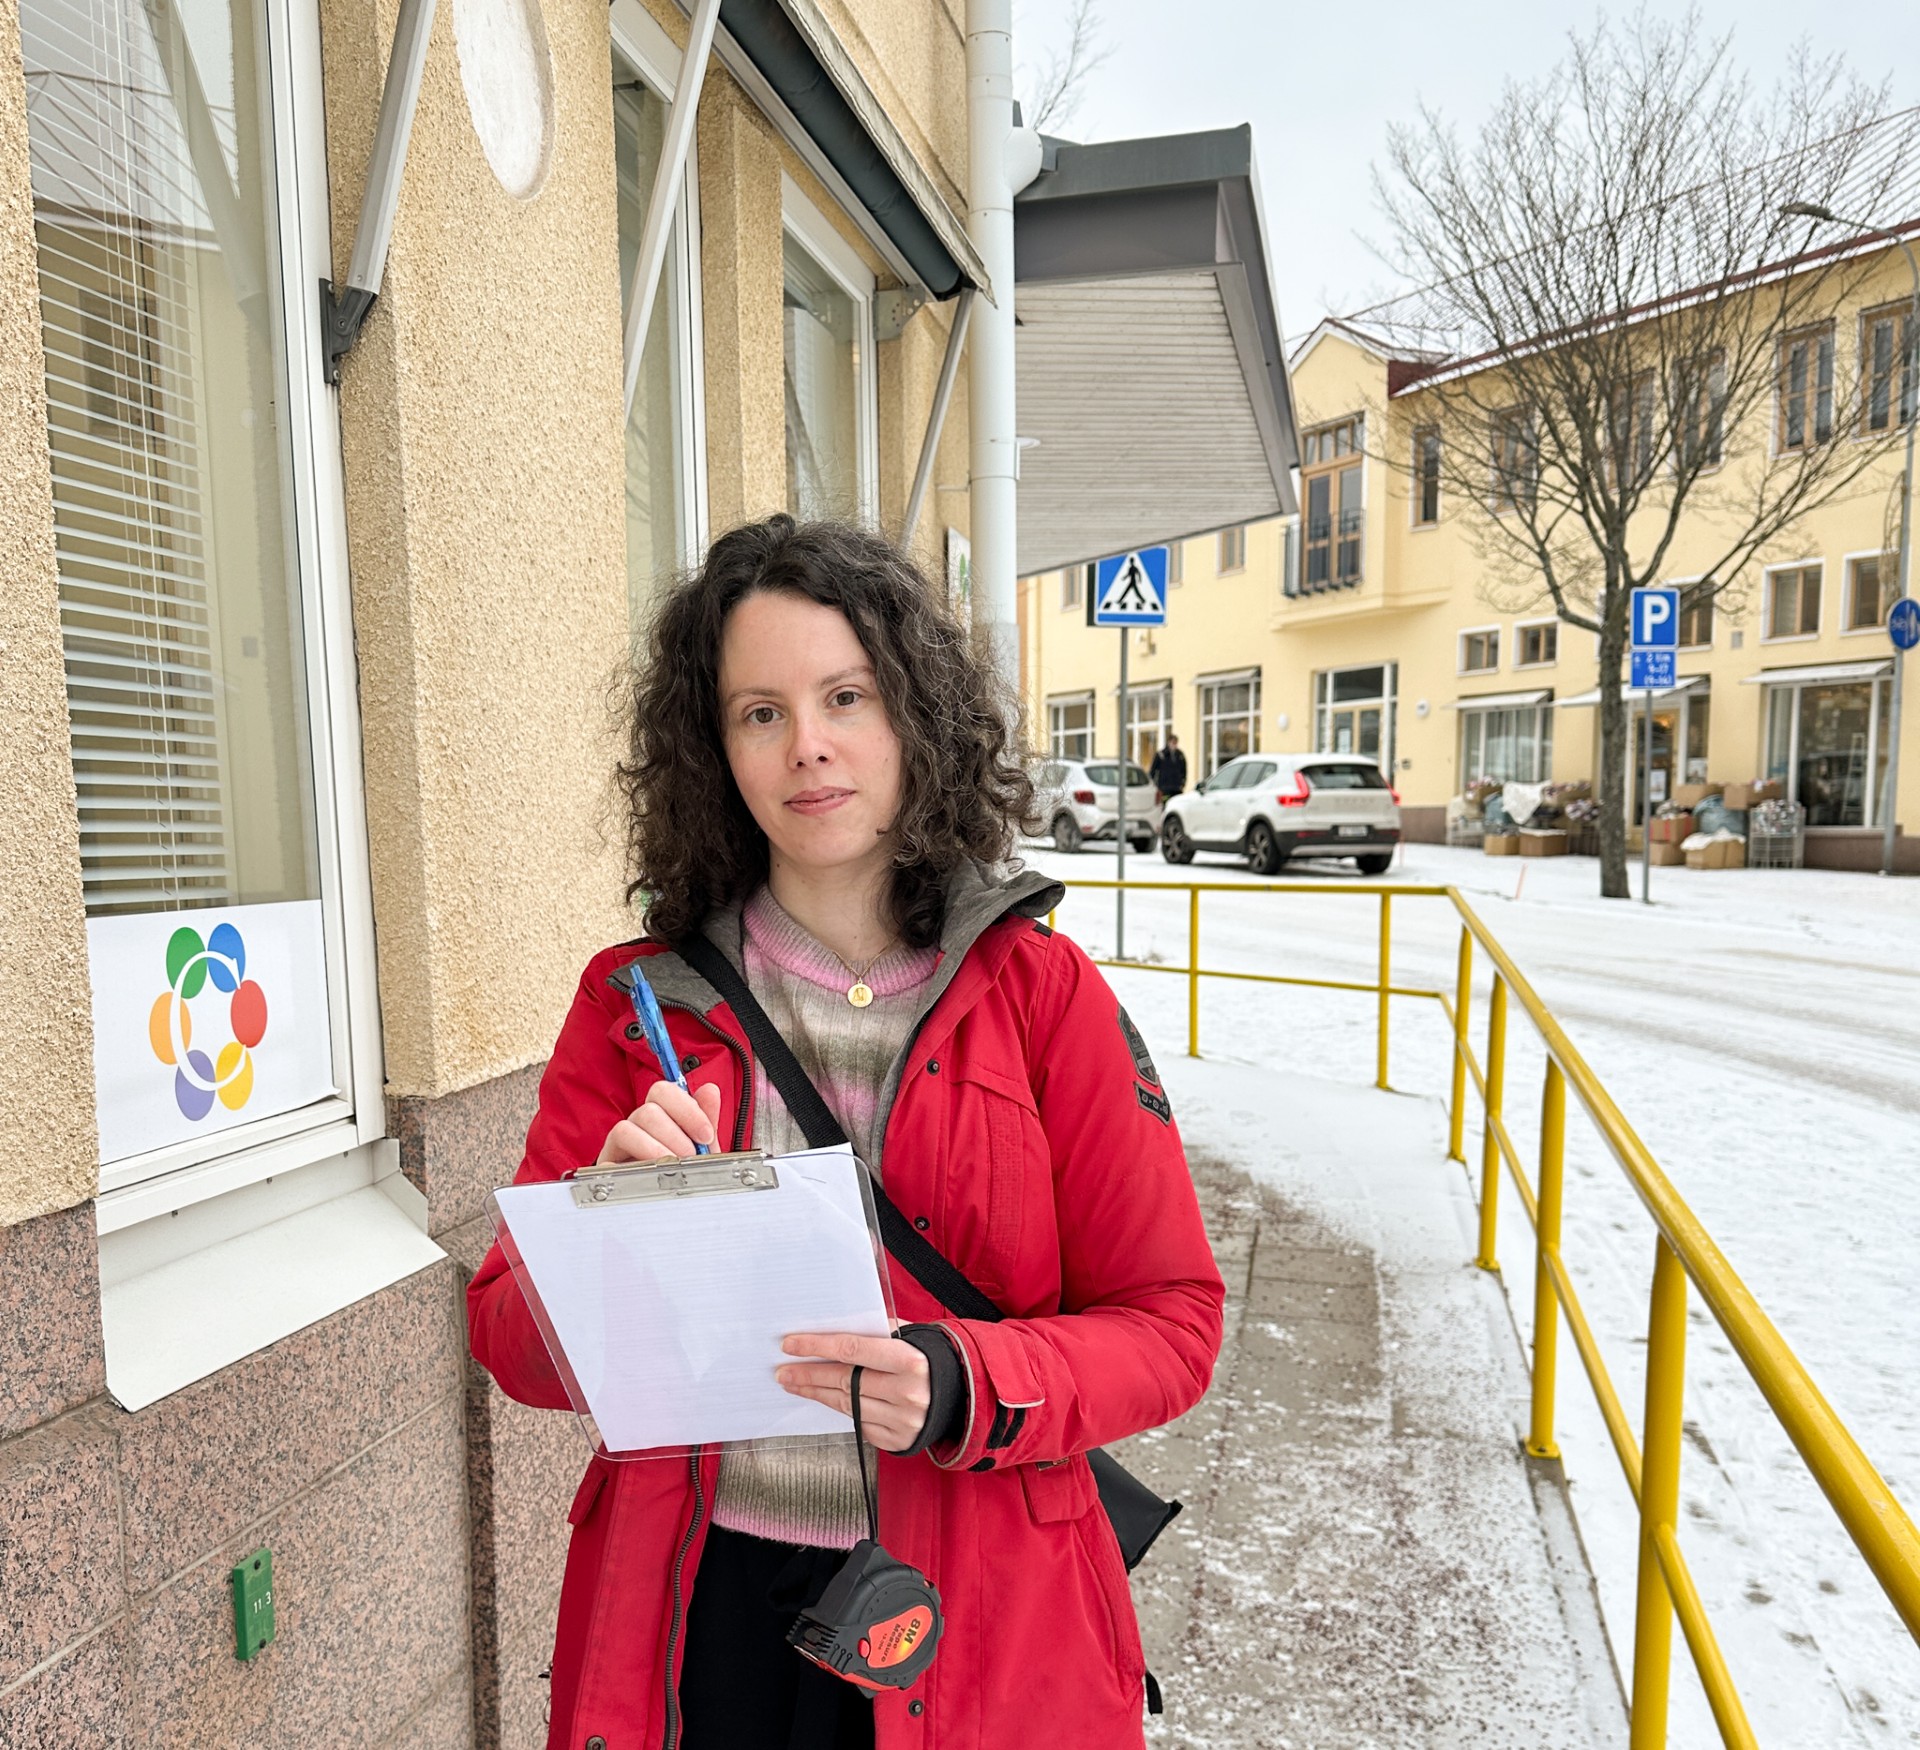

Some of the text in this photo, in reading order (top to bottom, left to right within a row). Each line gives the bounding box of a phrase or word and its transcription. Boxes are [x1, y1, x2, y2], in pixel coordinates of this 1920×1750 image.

[1643, 594, 1670, 643] P
[265, 1591, 272, 1605] 3
[881, 1623, 901, 1662] Measure
[893, 1627, 906, 1649] Tape
[904, 1618, 921, 1644] 8M
